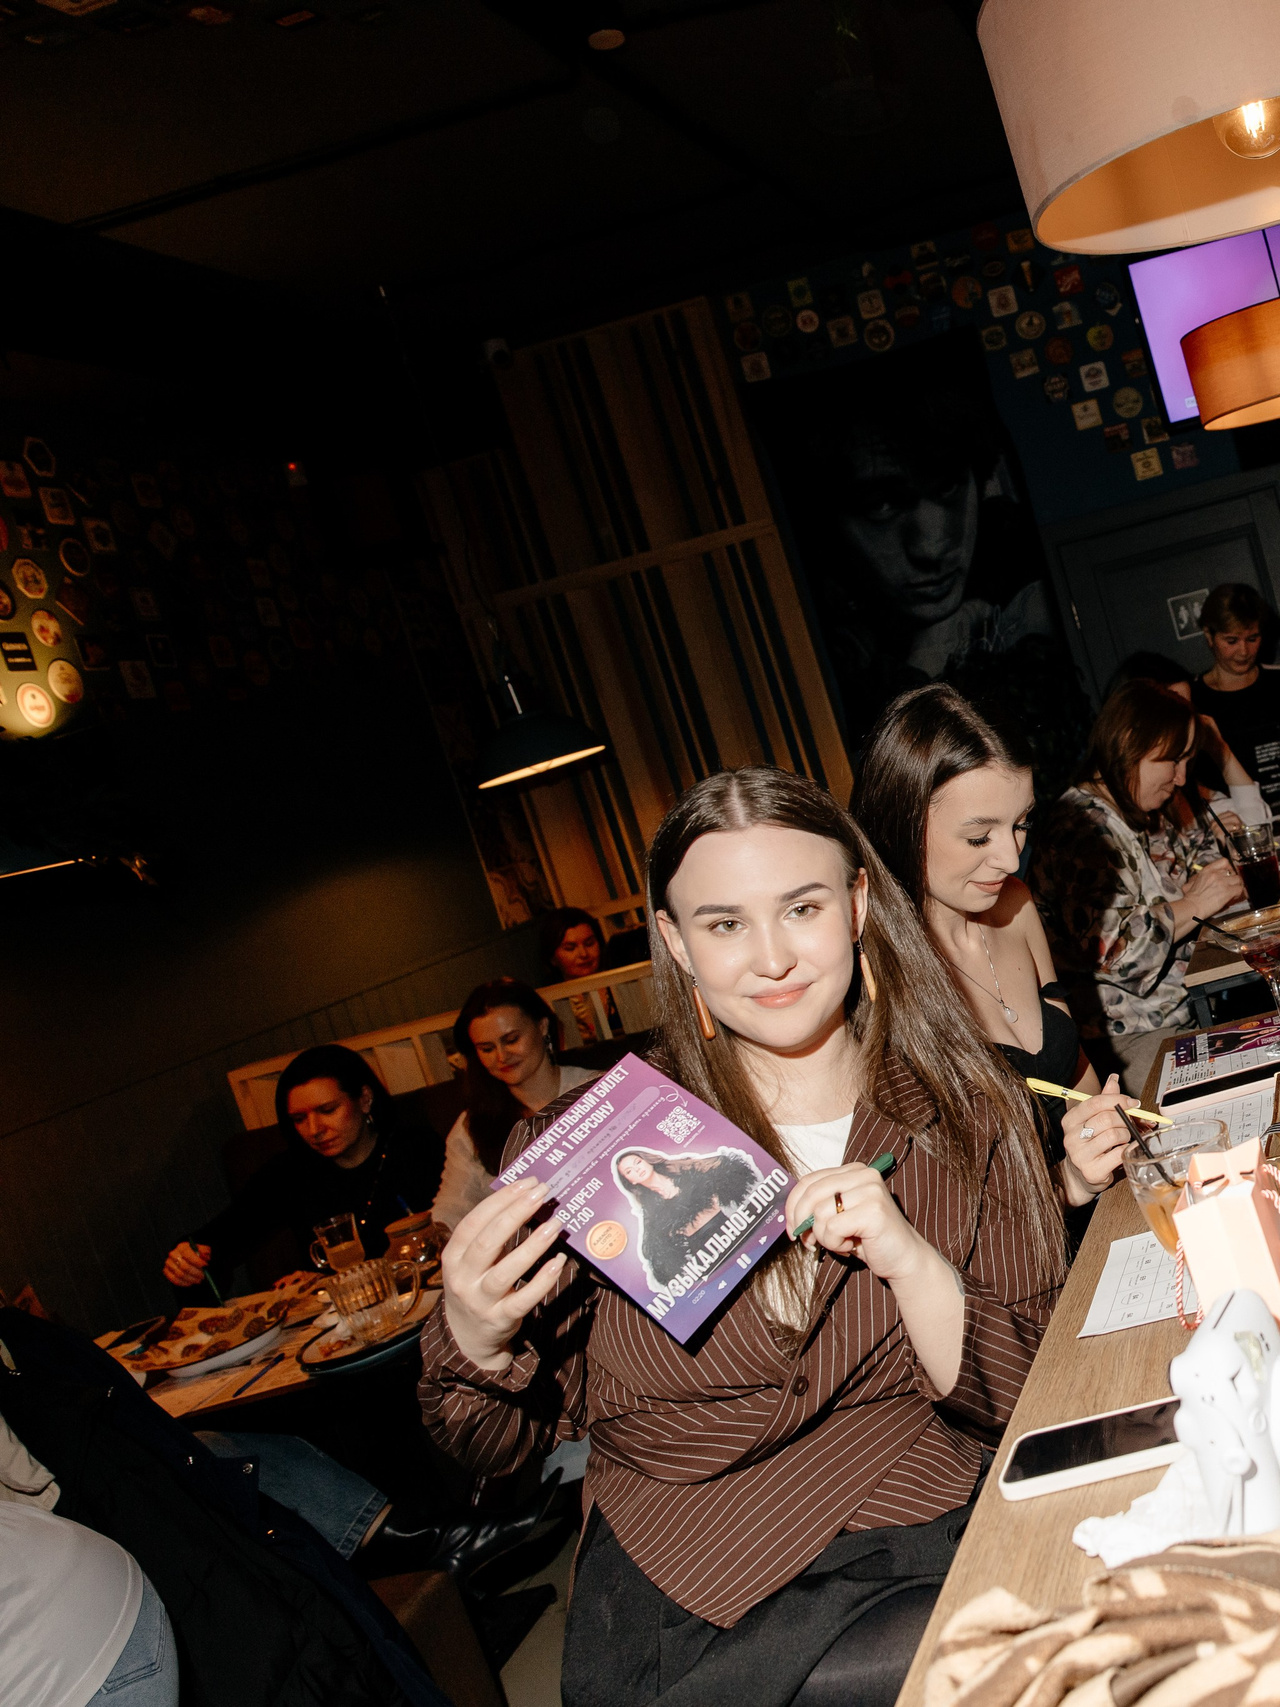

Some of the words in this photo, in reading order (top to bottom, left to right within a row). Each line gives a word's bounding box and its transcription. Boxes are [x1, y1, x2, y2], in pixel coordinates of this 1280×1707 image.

[500, 1092, 600, 1186] ПРИГЛАСИТЕЛЬНЫЙ
[593, 1064, 630, 1098] БИЛЕТ
[567, 1100, 615, 1145] ПЕРСОНУ
[545, 1148, 568, 1167] НА
[561, 1140, 575, 1151] 1
[555, 1209, 571, 1224] 18
[566, 1177, 604, 1214] АПРЕЛЯ
[566, 1206, 595, 1233] 17:00
[646, 1204, 757, 1321] МУЗЫКАЛЬНОЕ
[747, 1168, 790, 1214] ЛОТО
